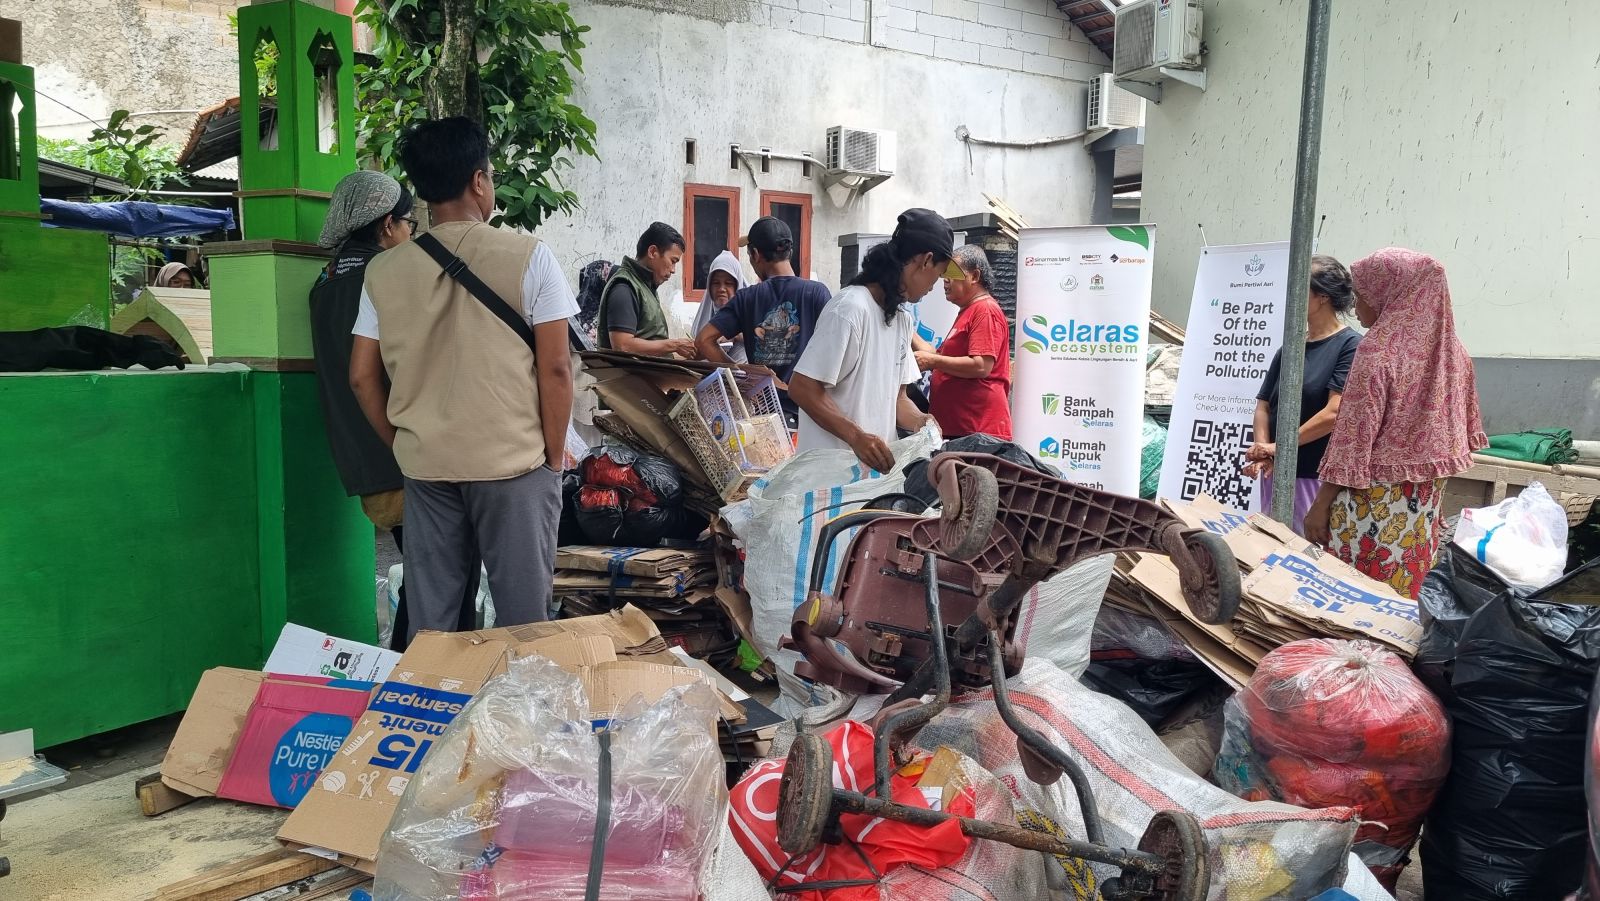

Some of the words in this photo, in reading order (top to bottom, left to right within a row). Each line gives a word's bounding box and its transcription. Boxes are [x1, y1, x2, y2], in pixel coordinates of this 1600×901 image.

[1222, 302, 1240, 314] Be
[1244, 302, 1274, 314] Part
[1223, 317, 1241, 330] Of
[1243, 318, 1267, 330] the
[1213, 333, 1271, 347] Solution
[1050, 343, 1138, 355] ecosystem
[1214, 350, 1238, 362] not
[1242, 350, 1265, 363] the
[1206, 365, 1268, 379] Pollution
[1064, 396, 1096, 407] Bank
[1194, 393, 1206, 401] For
[1207, 394, 1226, 402] More
[1227, 395, 1257, 405] Informa
[1063, 407, 1114, 420] Sampah
[1195, 402, 1219, 412] Check
[1220, 405, 1234, 413] Our
[1082, 417, 1114, 428] Selaras
[1062, 439, 1106, 451] Rumah
[1062, 449, 1102, 462] Pupuk
[1069, 460, 1101, 470] Selaras
[1074, 482, 1104, 491] mah
[1297, 586, 1346, 614] 15
[375, 690, 463, 714] sampai
[379, 714, 447, 737] menit
[275, 745, 320, 770] Pure
[368, 733, 433, 774] 15
